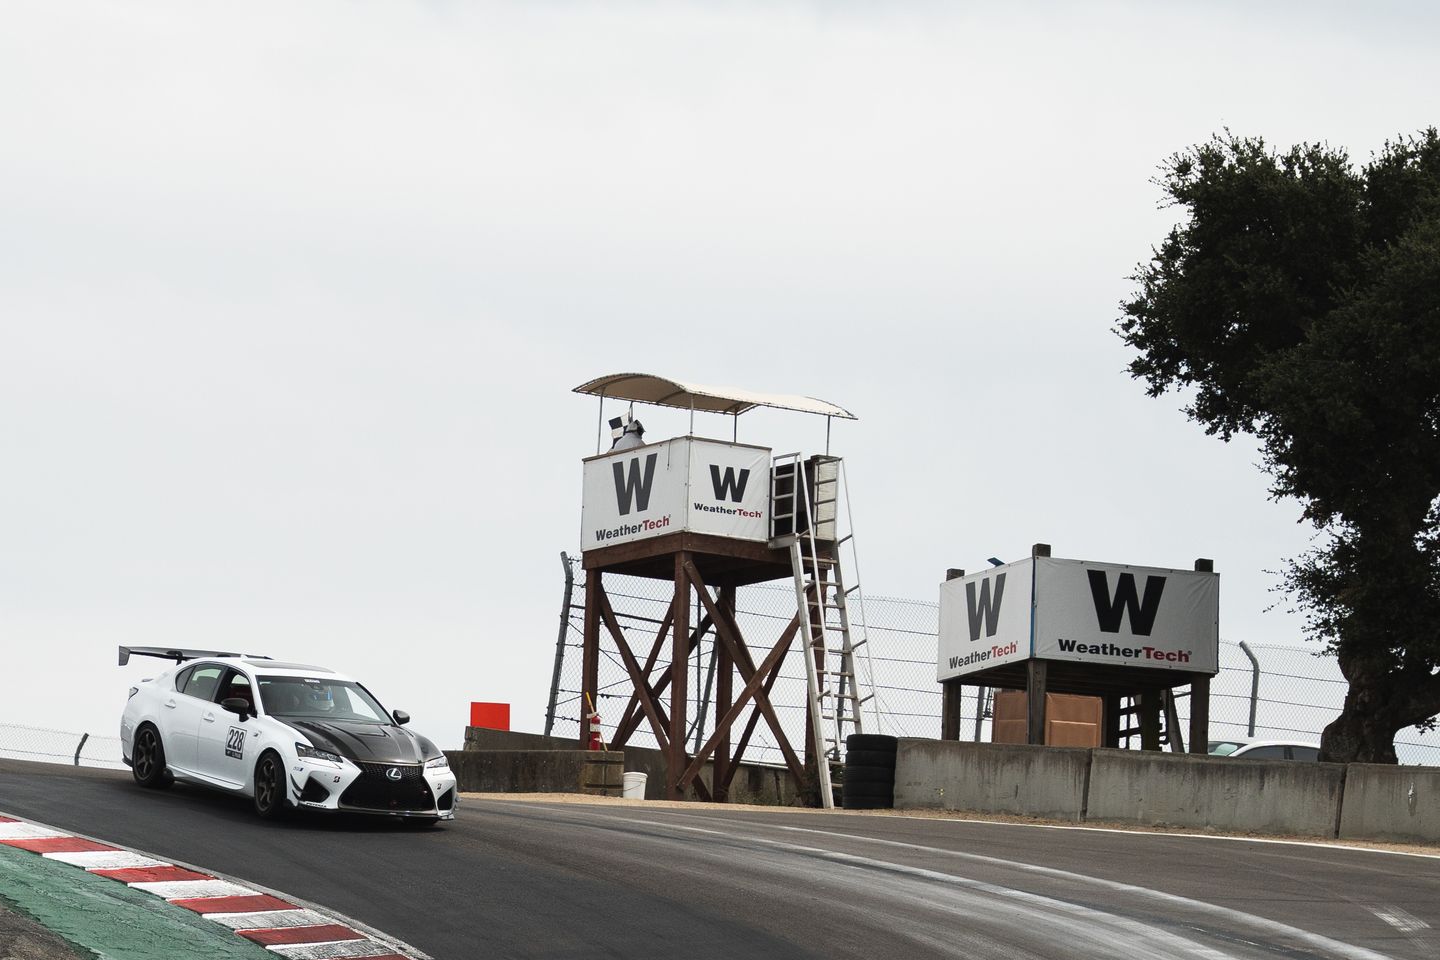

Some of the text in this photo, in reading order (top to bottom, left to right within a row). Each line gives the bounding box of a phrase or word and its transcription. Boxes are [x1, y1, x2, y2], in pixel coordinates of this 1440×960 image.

[612, 453, 658, 516] W
[709, 464, 751, 503] W
[694, 503, 762, 518] WeatherTech
[595, 515, 670, 541] WeatherTech
[965, 572, 1007, 642] W
[1086, 569, 1167, 637] W
[949, 641, 1017, 670] WeatherTech
[1058, 638, 1191, 663] WeatherTech
[227, 728, 245, 751] 228
